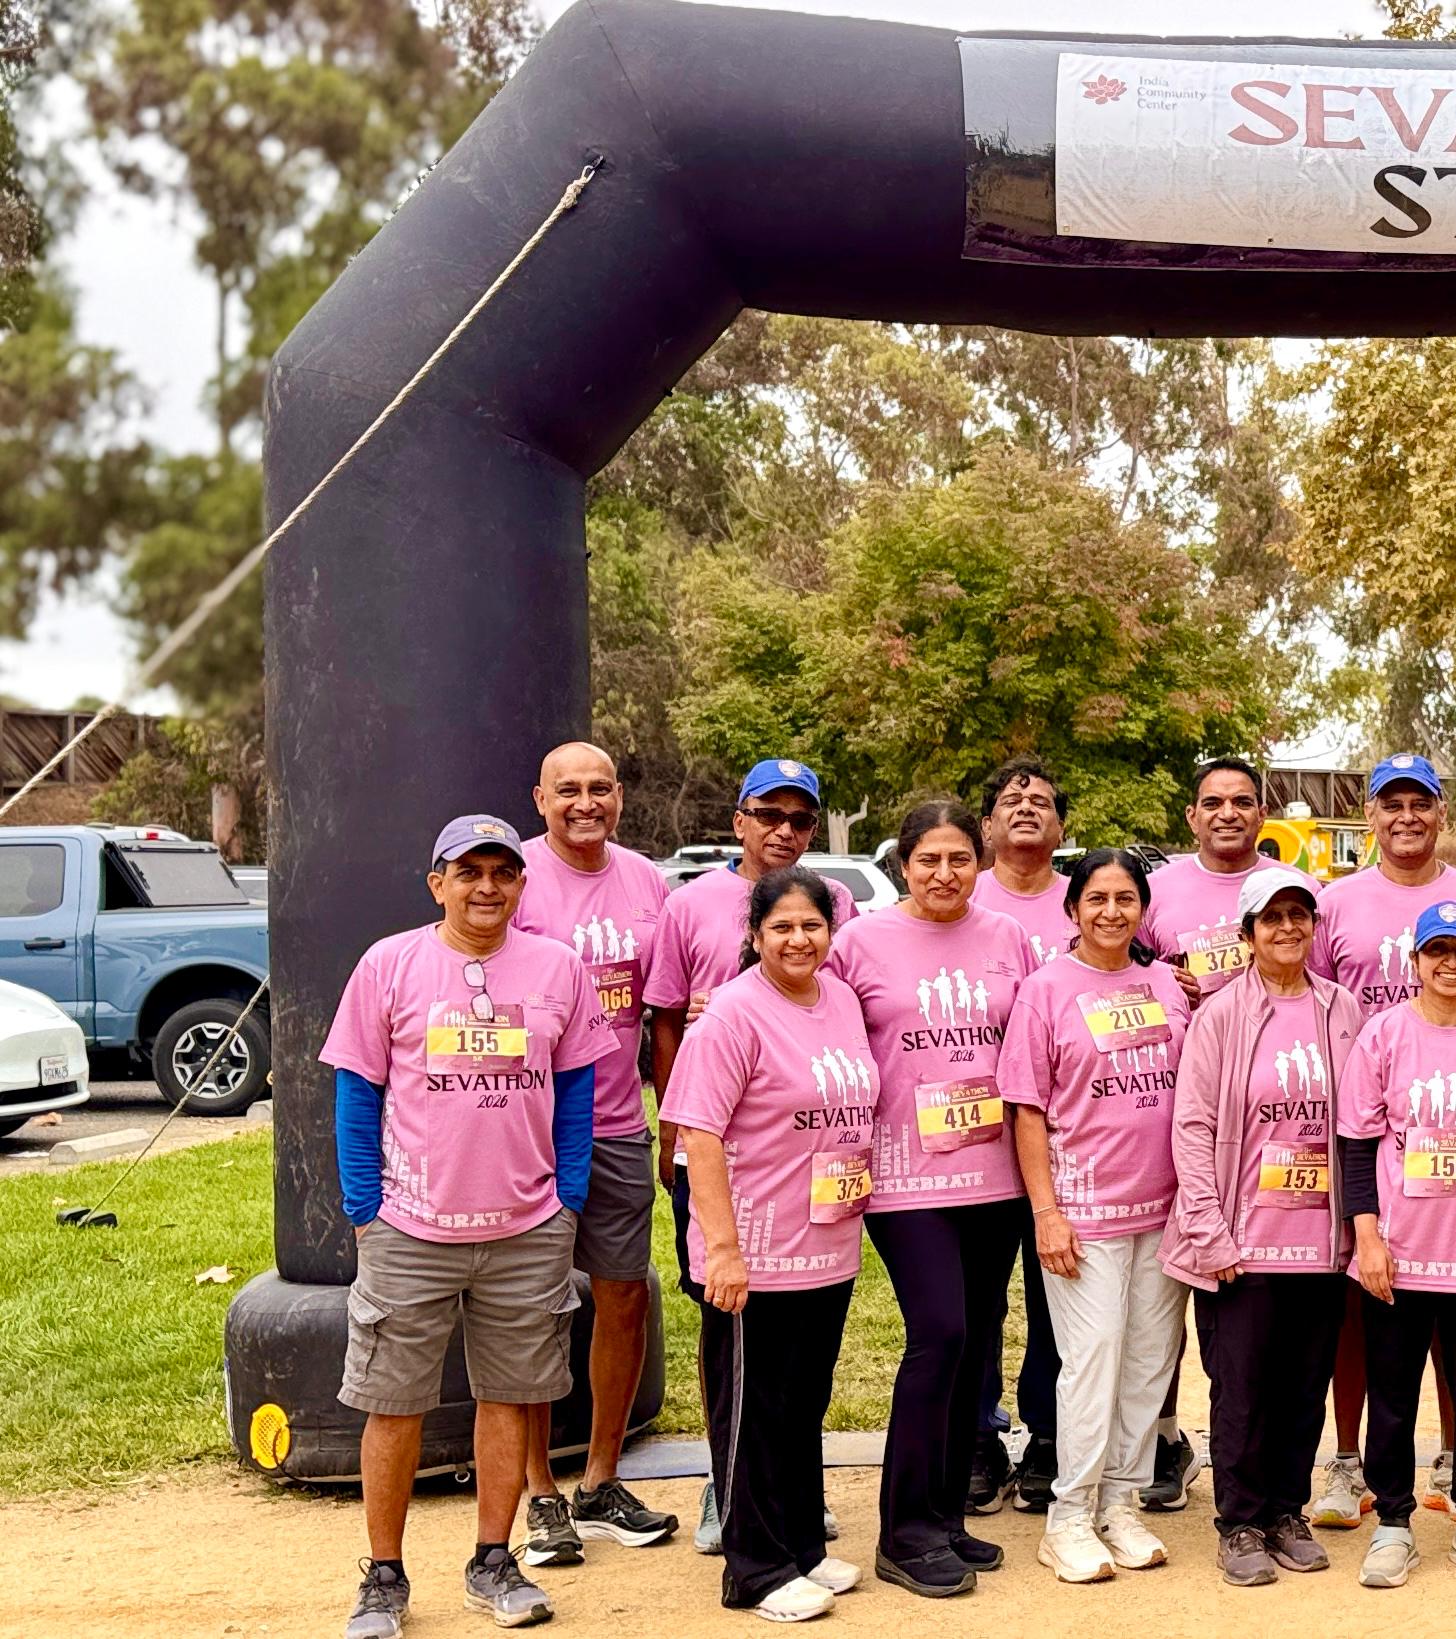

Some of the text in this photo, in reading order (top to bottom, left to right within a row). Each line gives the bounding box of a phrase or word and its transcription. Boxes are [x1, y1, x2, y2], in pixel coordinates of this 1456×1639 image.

[1139, 76, 1169, 87] India
[1137, 87, 1207, 101] Community
[1137, 99, 1177, 110] Center
[1206, 946, 1243, 971] 373
[598, 985, 633, 1011] 066
[1361, 984, 1423, 1005] SEVAT
[1109, 1007, 1146, 1030] 210
[456, 1030, 499, 1053] 155
[901, 1026, 1005, 1052] SEVATHON
[949, 1049, 975, 1063] 2026
[427, 1069, 547, 1092] SEVATHON
[1091, 1070, 1177, 1099] SEVATHO
[477, 1094, 509, 1109] 2026
[1135, 1094, 1159, 1109] 2026
[944, 1103, 982, 1129] 414
[837, 1129, 861, 1144] 2026
[1298, 1123, 1323, 1137] 2026
[836, 1176, 864, 1201] 375
[872, 1171, 985, 1194] CELEBRATE
[1282, 1168, 1319, 1190] 153
[1240, 1246, 1319, 1261] EBRATE
